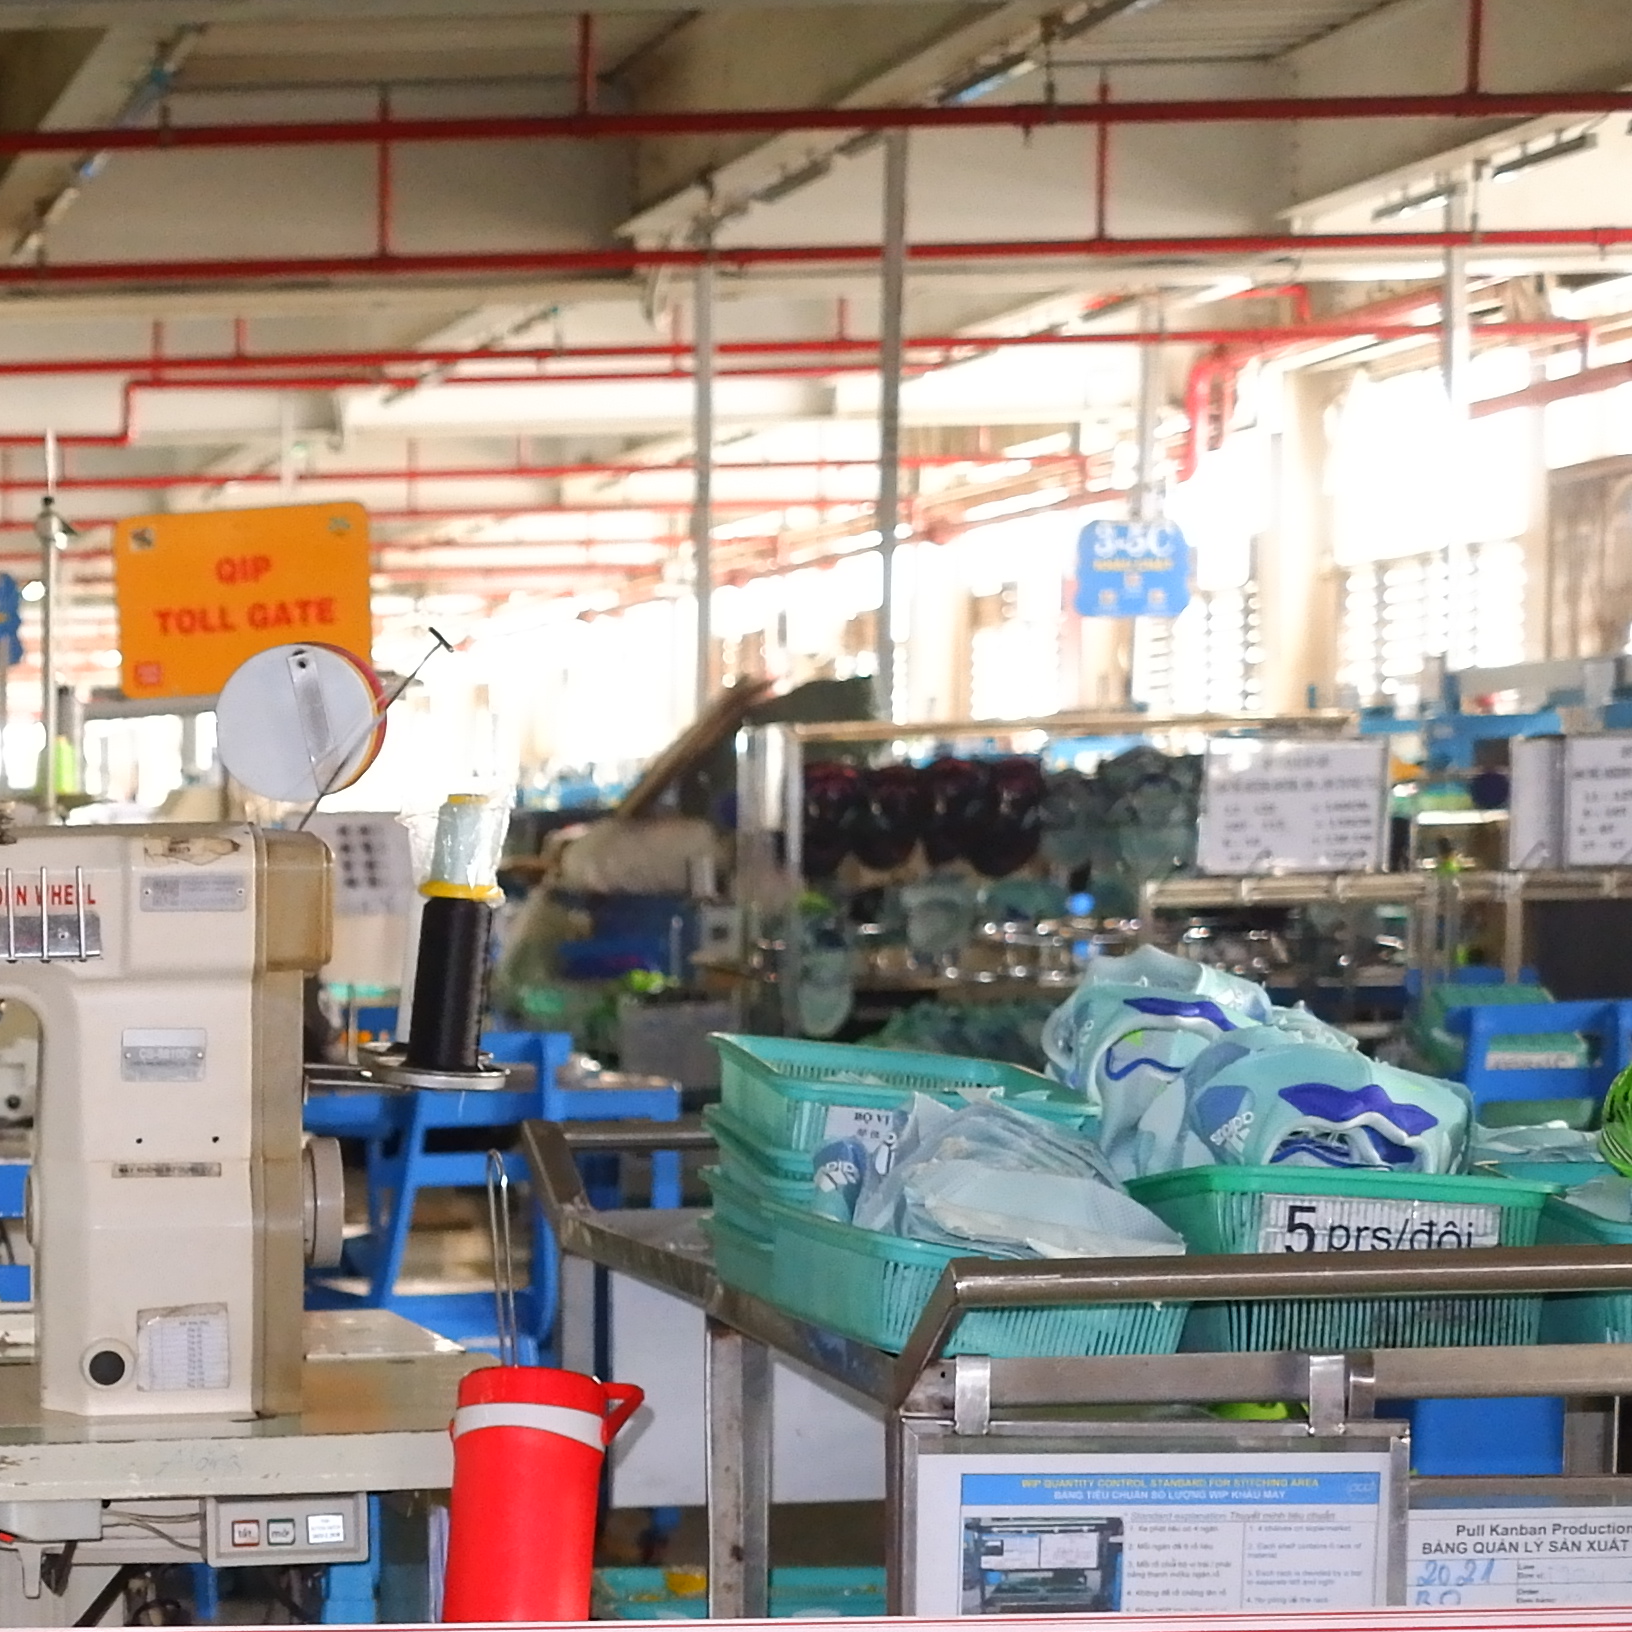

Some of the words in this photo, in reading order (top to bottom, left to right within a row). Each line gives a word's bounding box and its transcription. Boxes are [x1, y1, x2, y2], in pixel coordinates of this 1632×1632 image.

[215, 554, 272, 585] QIP
[153, 605, 236, 637] TOLL
[247, 597, 336, 630] GATE
[1285, 1205, 1316, 1252] 5
[1097, 1479, 1145, 1488] CONTROL
[1456, 1524, 1485, 1537] Pull
[1490, 1523, 1547, 1536] Kanban
